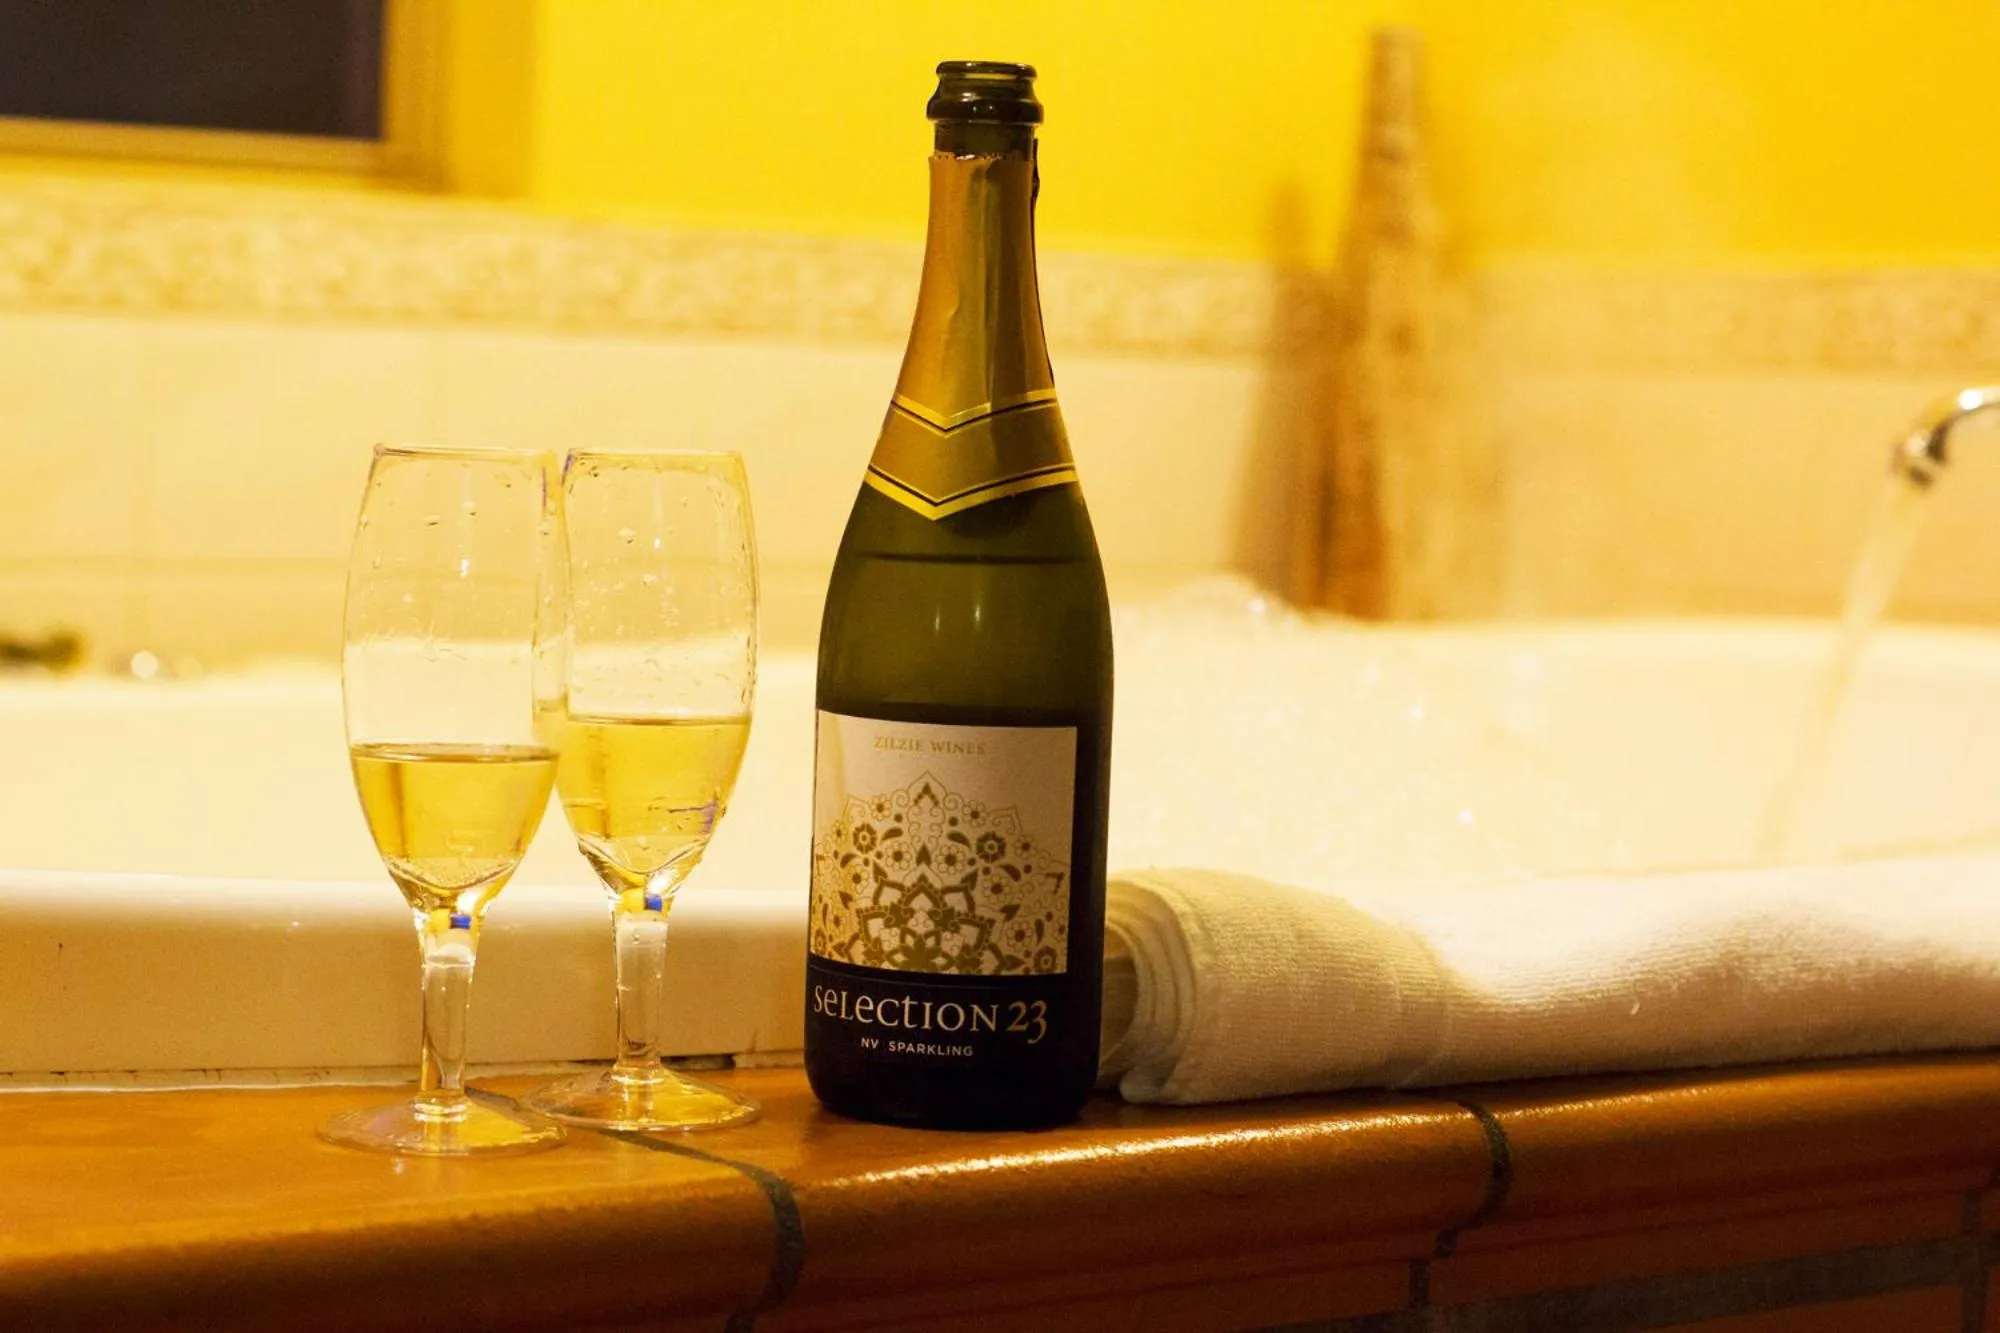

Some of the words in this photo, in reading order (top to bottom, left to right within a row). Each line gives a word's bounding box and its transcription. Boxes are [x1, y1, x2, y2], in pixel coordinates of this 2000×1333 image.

[874, 736, 924, 753] ZILZIE
[931, 738, 986, 755] WINES
[1007, 1000, 1048, 1044] 23
[860, 1037, 880, 1049] NV
[889, 1040, 974, 1057] SPARKLING
